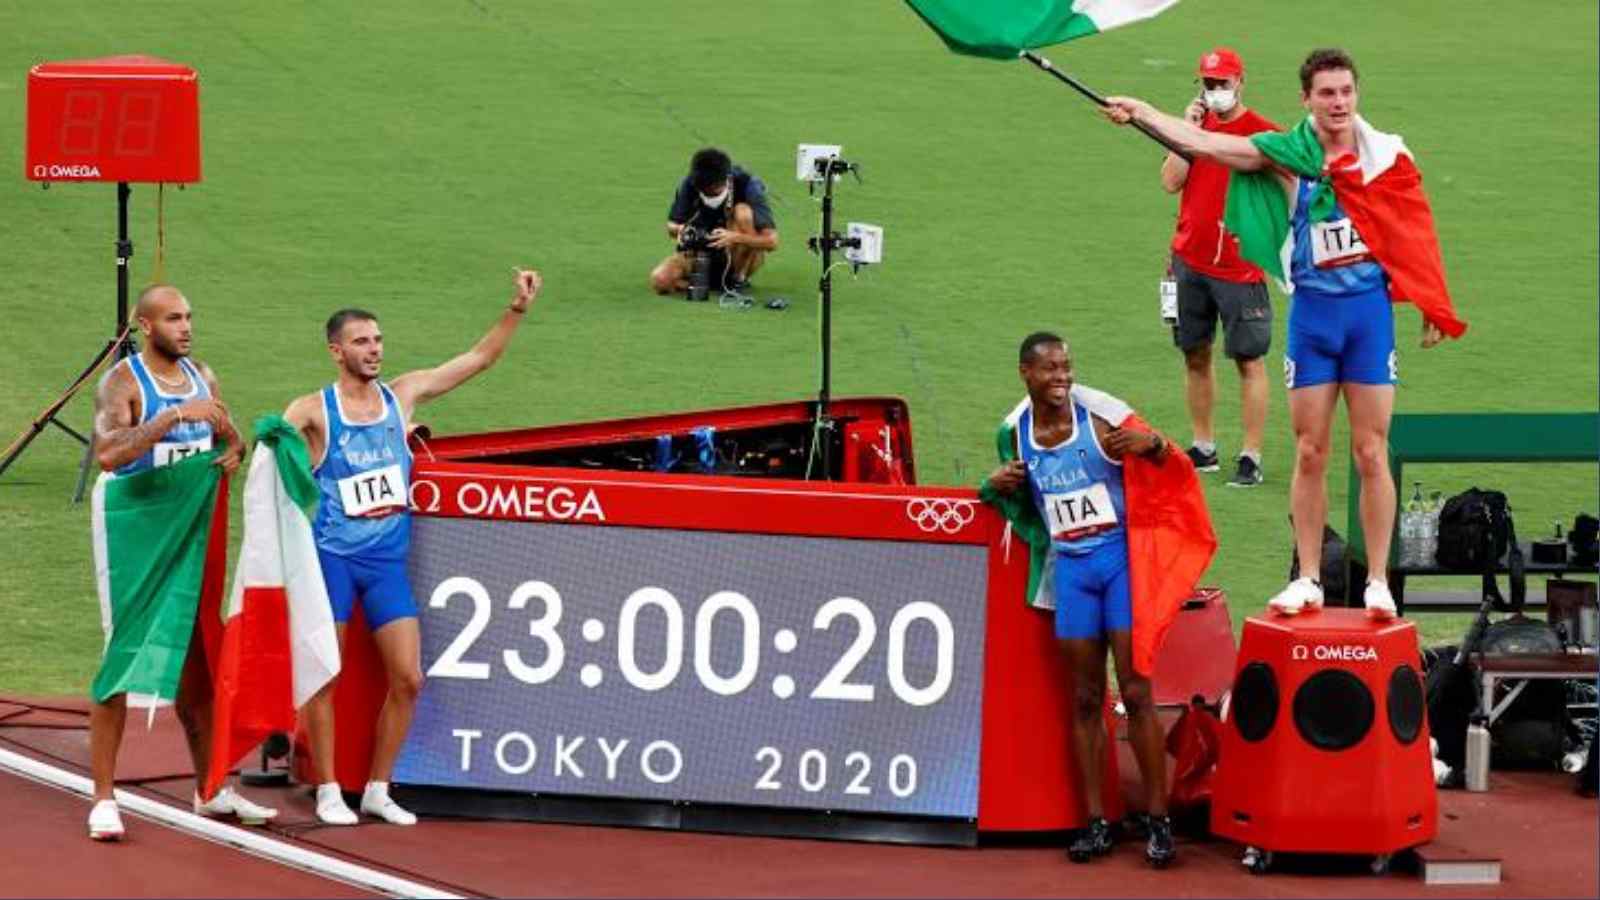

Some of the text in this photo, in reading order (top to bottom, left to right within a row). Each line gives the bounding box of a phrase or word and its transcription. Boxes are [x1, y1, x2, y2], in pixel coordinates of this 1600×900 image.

[50, 164, 101, 177] OMEGA
[353, 473, 395, 505] ITA
[457, 482, 606, 521] OMEGA
[1054, 495, 1099, 524] ITA
[426, 576, 955, 706] 23:00:20
[1314, 645, 1378, 661] OMEGA
[452, 729, 918, 797] TOKYO 2020
